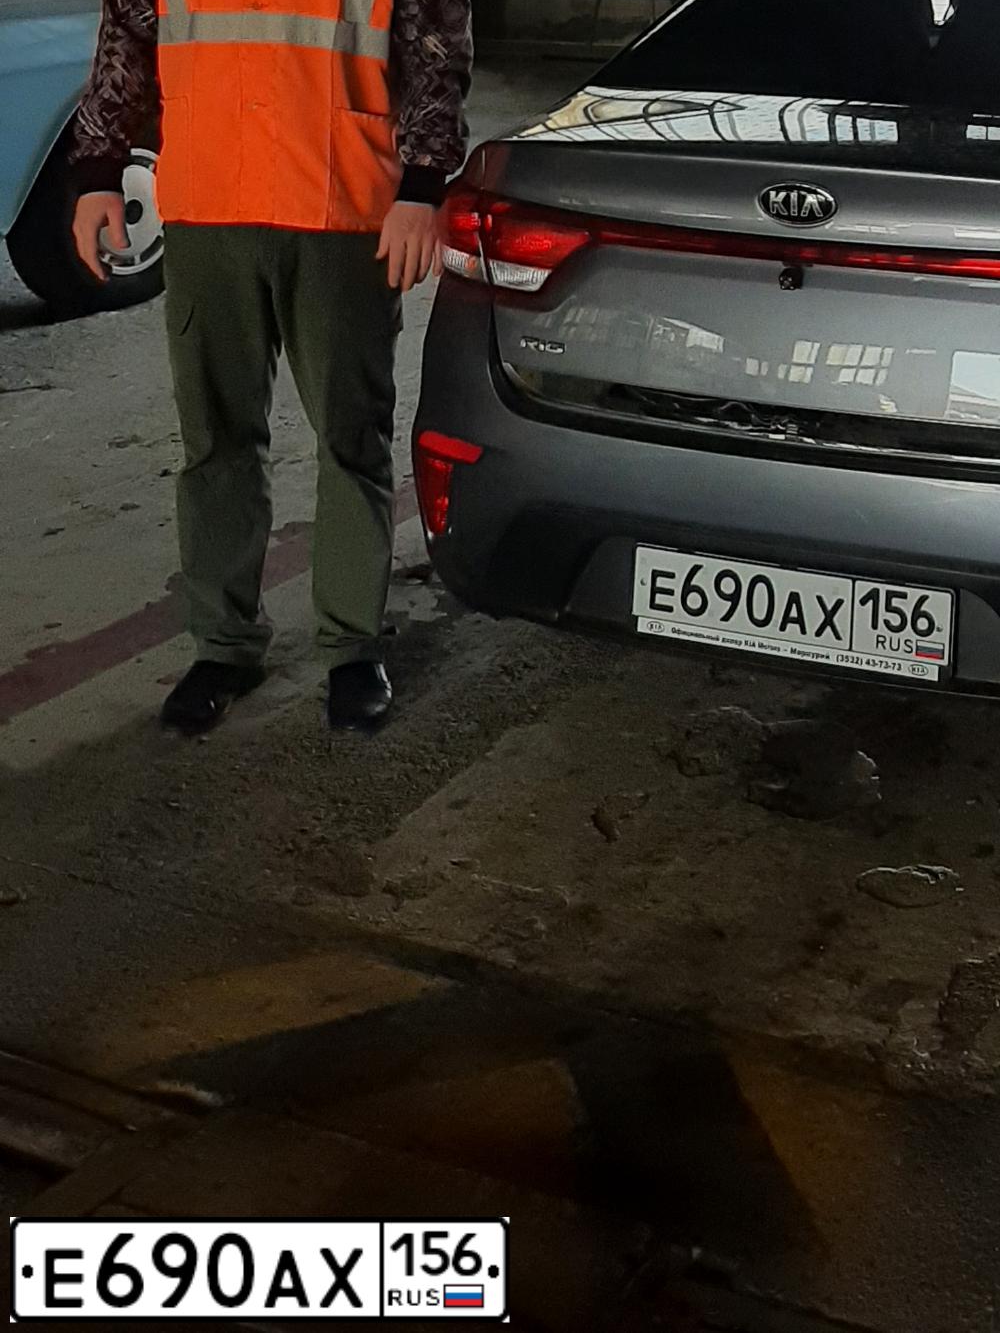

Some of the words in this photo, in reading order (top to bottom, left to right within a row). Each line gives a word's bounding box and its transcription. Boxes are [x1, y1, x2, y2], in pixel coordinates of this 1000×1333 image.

[767, 188, 827, 218] KIA
[859, 587, 935, 638] 156
[876, 634, 913, 654] RUS
